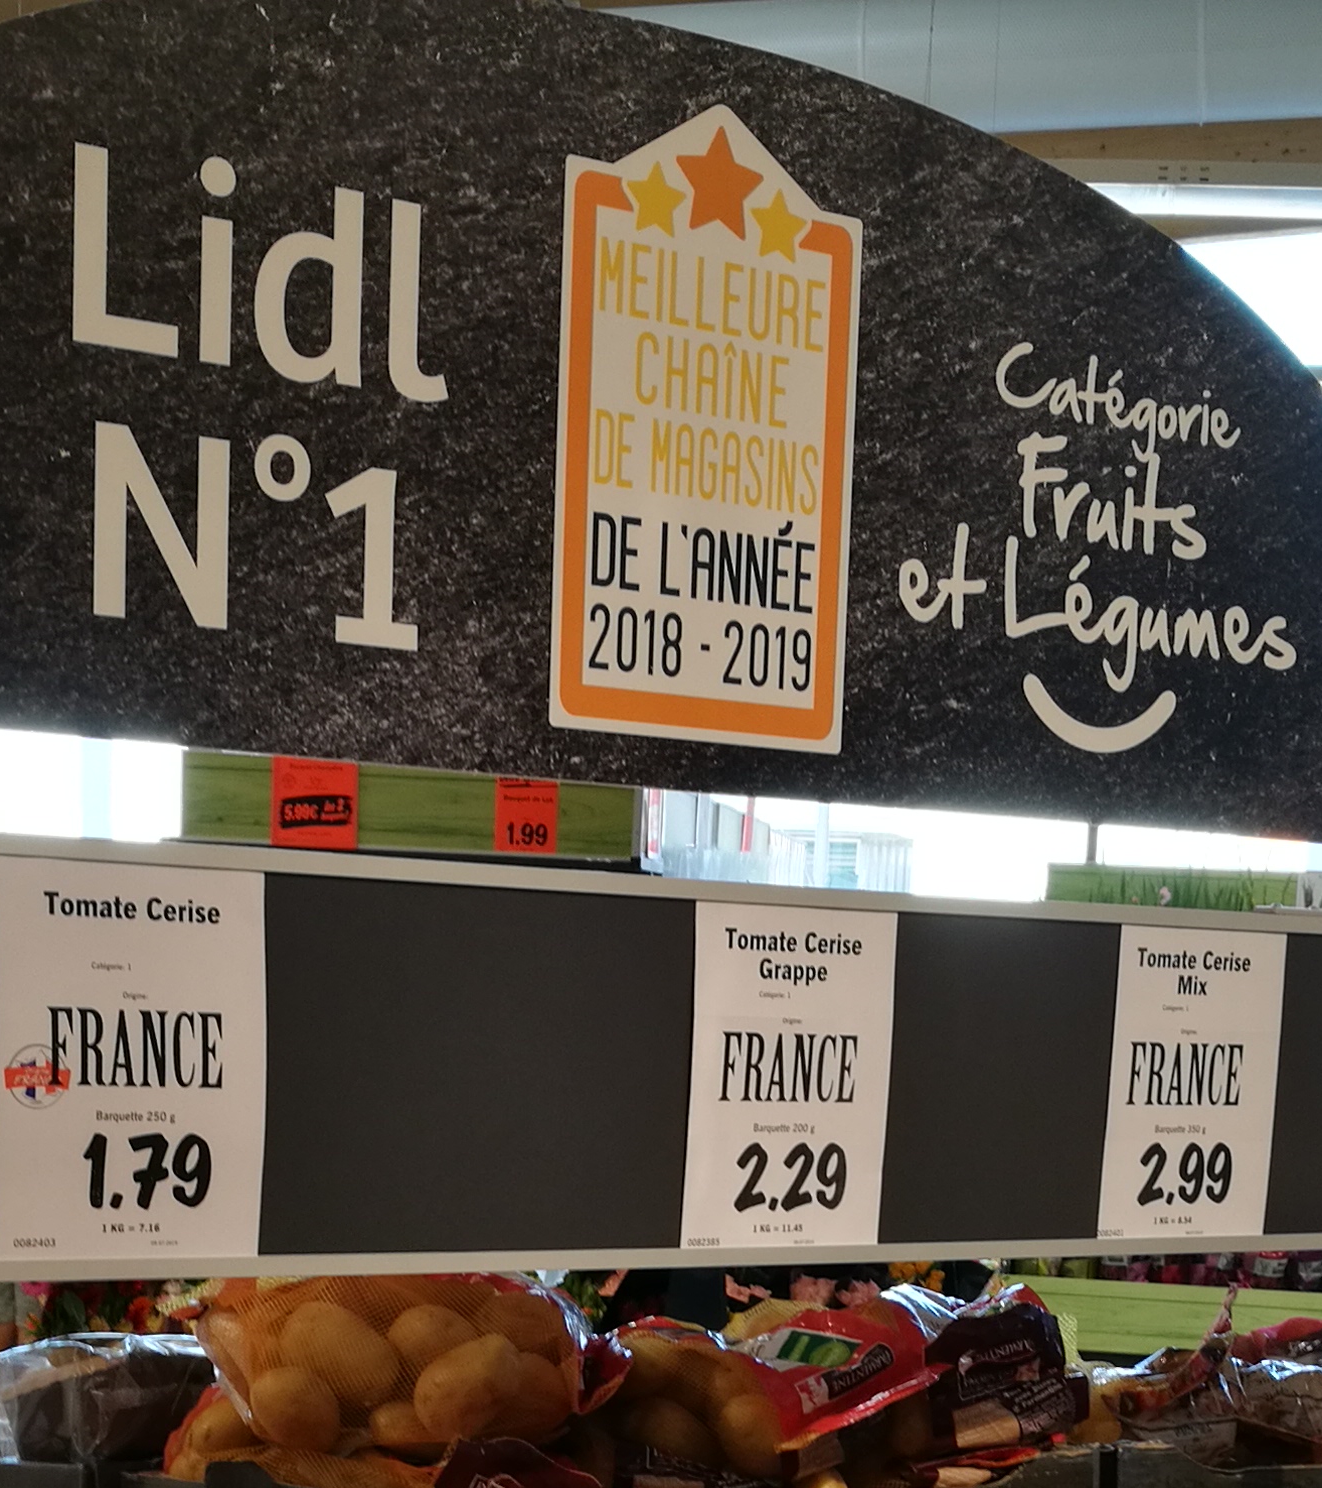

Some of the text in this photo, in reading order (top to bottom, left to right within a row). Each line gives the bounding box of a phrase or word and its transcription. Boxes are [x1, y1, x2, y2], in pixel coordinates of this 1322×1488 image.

[73, 141, 448, 404] Lidl
[596, 241, 827, 353] MEILLEURE
[633, 331, 788, 431] CHAÎNE
[994, 340, 1241, 452] Catégorie
[593, 405, 819, 517] DE MAGASINS
[1015, 434, 1208, 562] Fruits
[91, 419, 420, 654] N°1
[592, 510, 817, 615] DE L'ANNÉE
[899, 521, 1298, 692] et Légumes
[589, 603, 812, 695] 2018 2019
[507, 821, 548, 847] 1.99
[43, 890, 220, 924] Tomate Cerise
[725, 927, 862, 956] Tomate Cerise
[759, 958, 828, 986] Grappe
[1137, 947, 1251, 973] Tomate Cerise
[1177, 975, 1208, 996] Mix
[46, 1005, 223, 1089] FRANCE
[718, 1031, 858, 1103] FRANCE
[1126, 1041, 1244, 1106] FRANCE
[95, 1110, 144, 1124] Barquette
[147, 1111, 167, 1122] 250
[753, 1123, 808, 1135] Barquette 200
[83, 1133, 211, 1210] 1.79
[734, 1142, 847, 1213] 2.29
[1137, 1142, 1232, 1206] 2.99
